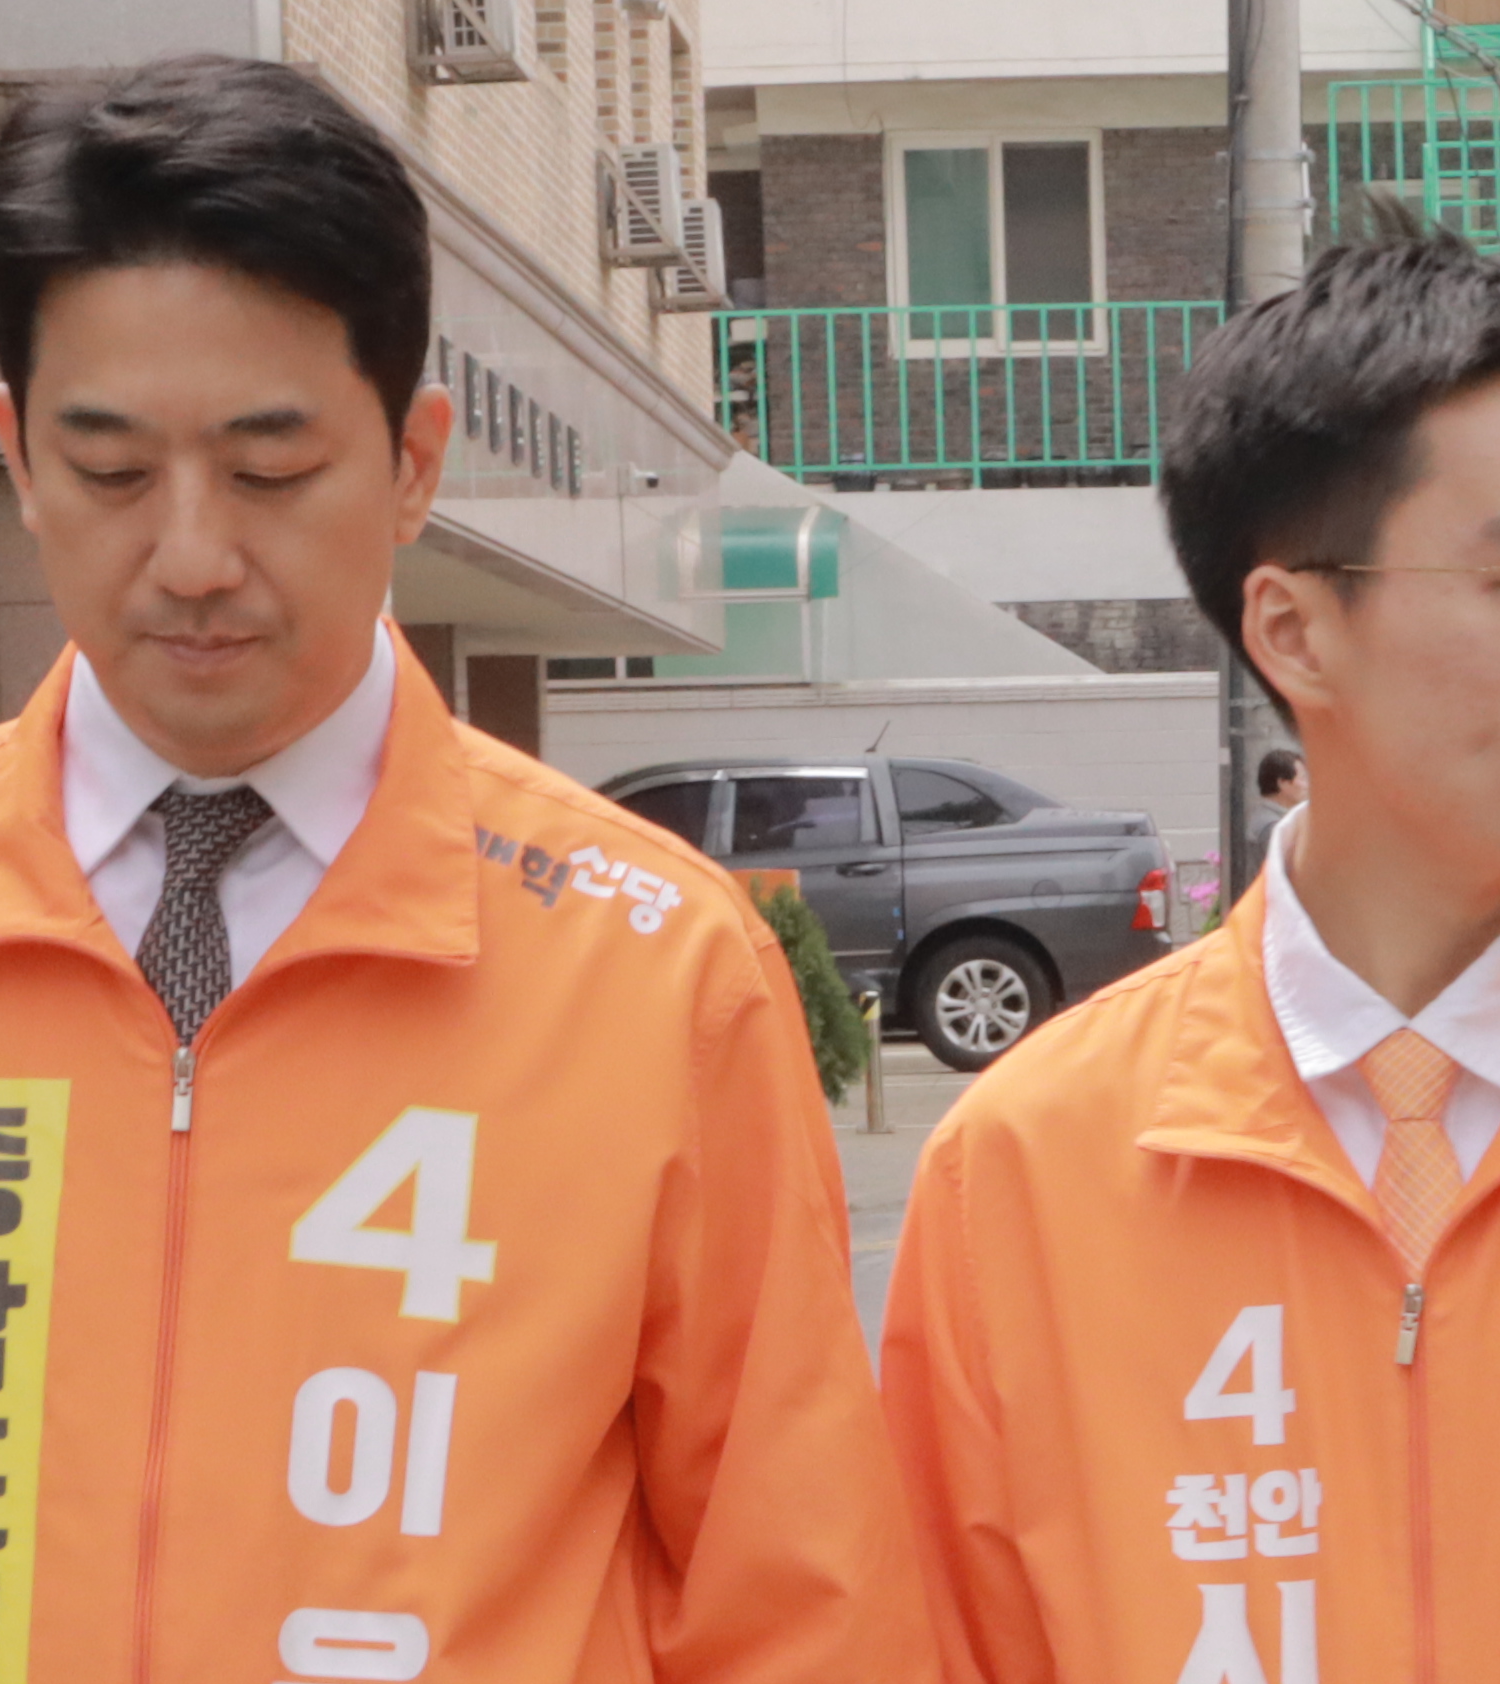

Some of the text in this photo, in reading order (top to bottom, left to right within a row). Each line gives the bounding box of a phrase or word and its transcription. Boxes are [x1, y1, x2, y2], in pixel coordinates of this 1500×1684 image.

[288, 1105, 498, 1324] 4
[1183, 1304, 1296, 1446] 4
[1165, 1468, 1323, 1562] 천안
